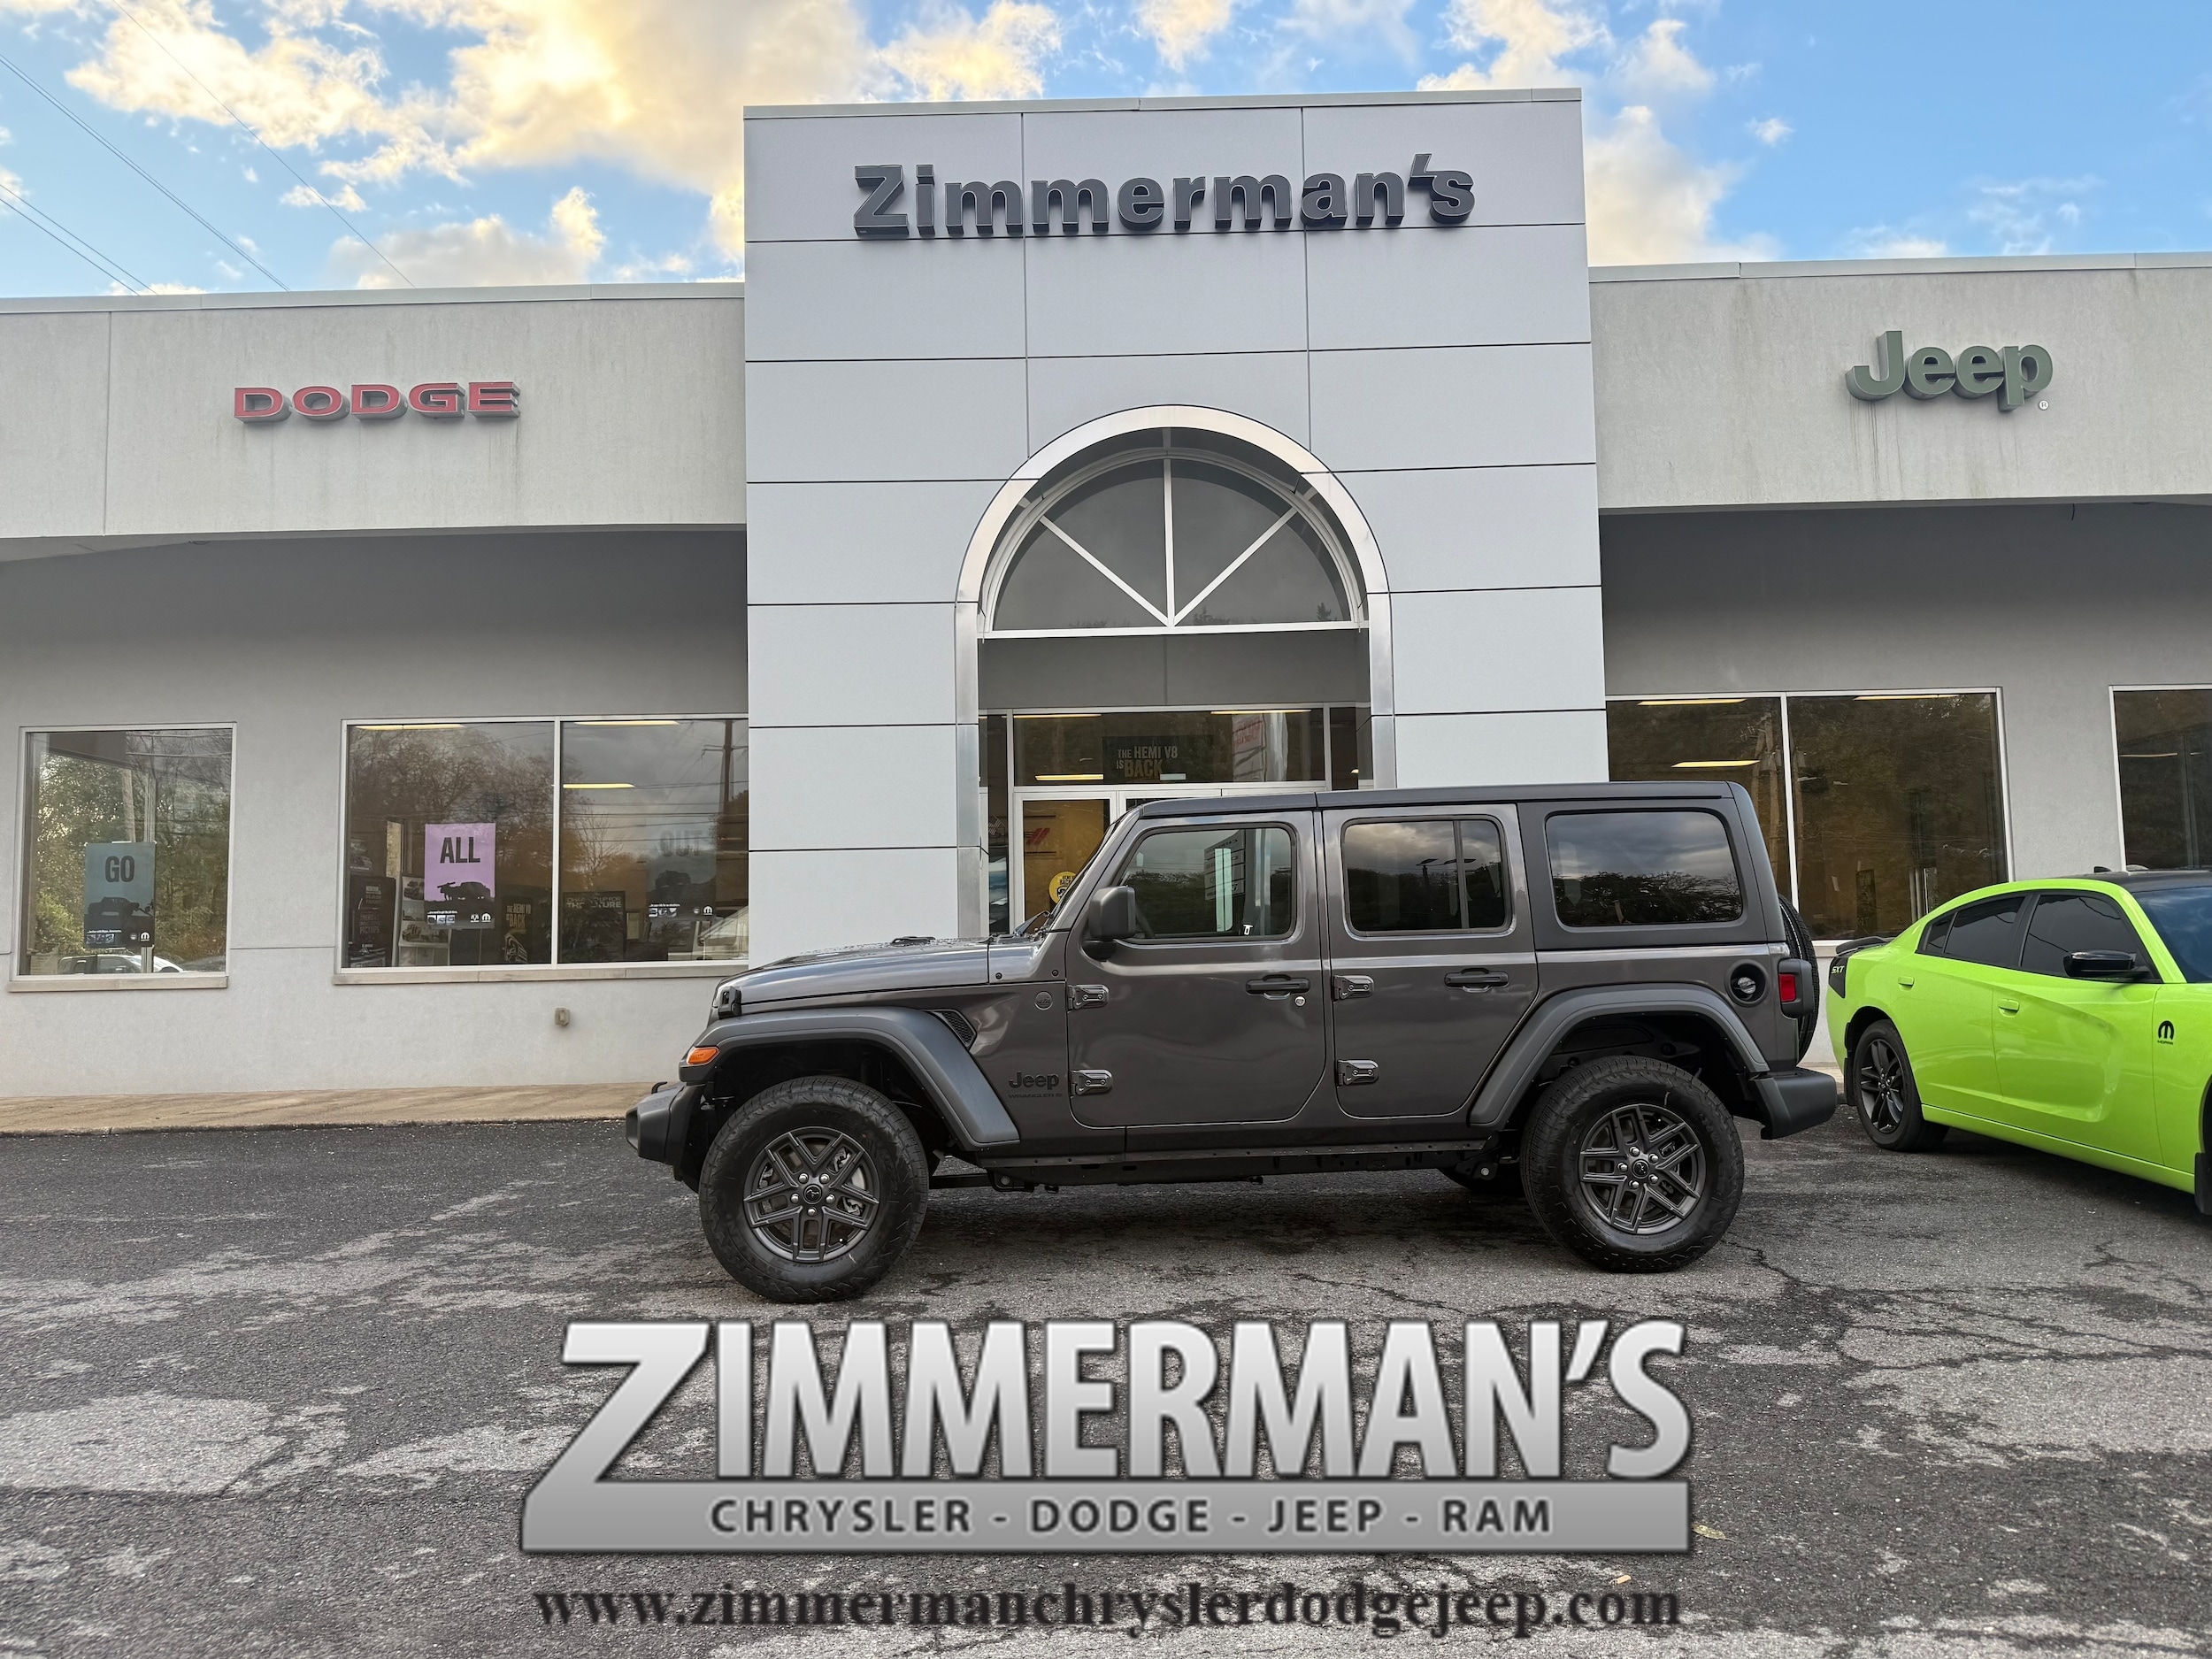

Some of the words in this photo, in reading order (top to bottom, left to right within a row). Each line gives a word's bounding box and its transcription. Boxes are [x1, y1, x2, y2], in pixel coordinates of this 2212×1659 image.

[854, 154, 1475, 237] Zimmerman's
[1846, 330, 2054, 412] Jeep
[234, 381, 520, 423] DODGE
[1117, 749, 1133, 758] THE
[1133, 746, 1162, 759] HEMI
[1164, 746, 1179, 759] V8
[1116, 759, 1125, 770] IS
[1124, 759, 1164, 778] BACK
[440, 836, 481, 864] ALL
[659, 831, 702, 857] OUT
[104, 855, 135, 883] GO
[1832, 965, 1845, 974] SXT
[1009, 1071, 1060, 1090] Jeep
